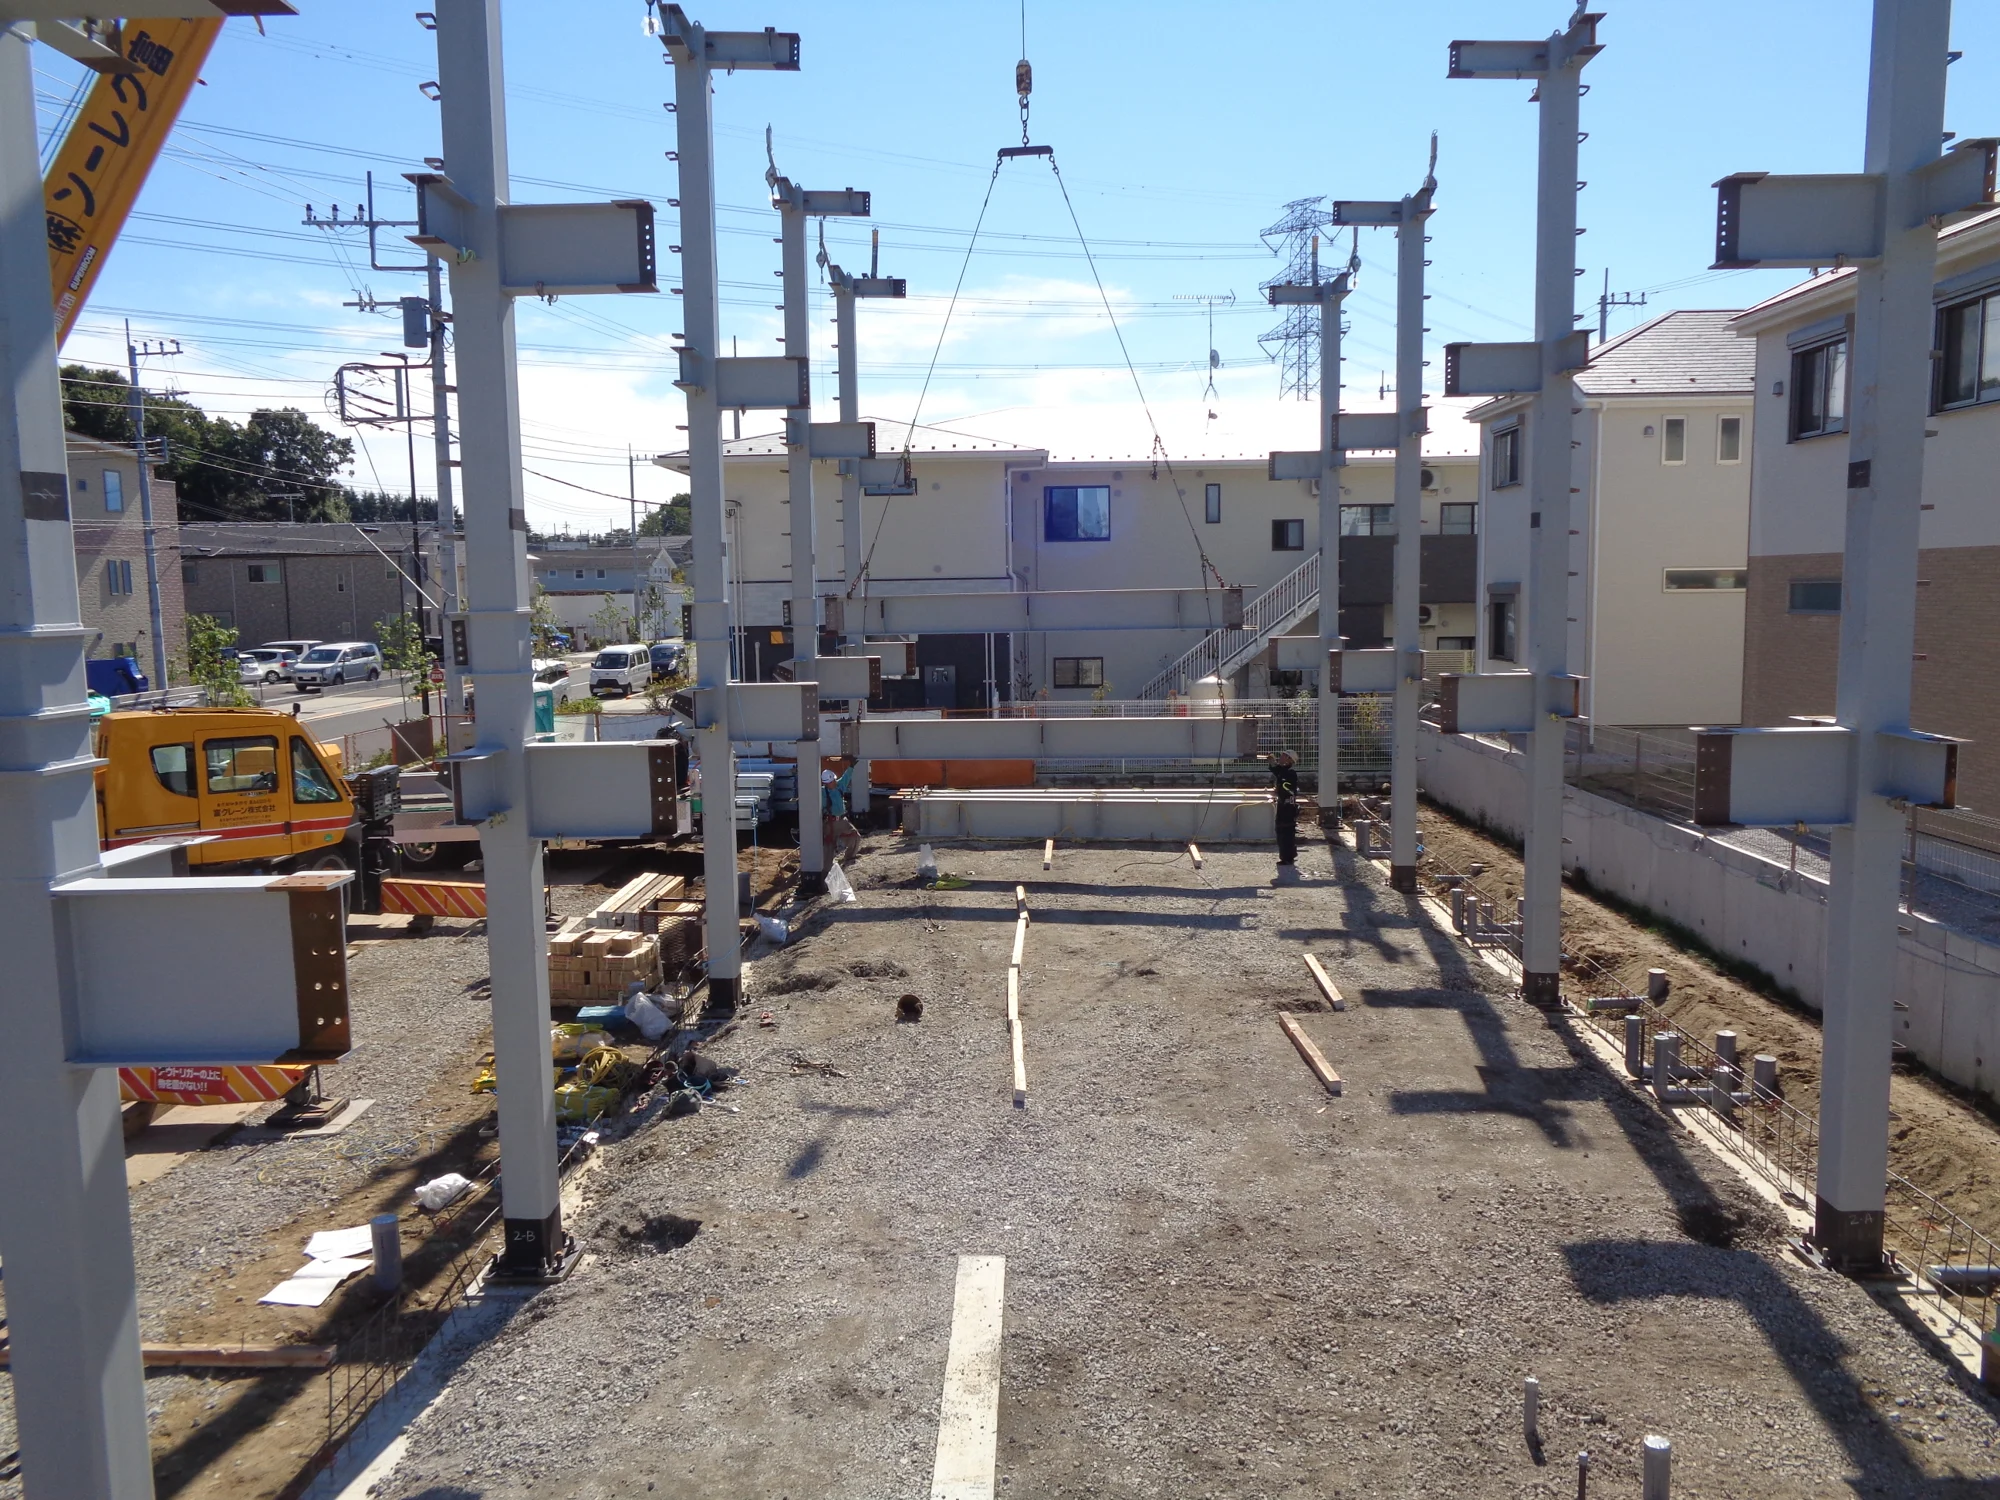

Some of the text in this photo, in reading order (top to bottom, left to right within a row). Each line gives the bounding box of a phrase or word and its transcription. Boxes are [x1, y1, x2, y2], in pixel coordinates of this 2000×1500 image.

[70, 247, 97, 290] SUPERBOOM
[213, 804, 276, 817] 富クレーン株式会社
[1849, 1212, 1873, 1225] 2-A
[513, 1230, 536, 1242] 2-B
